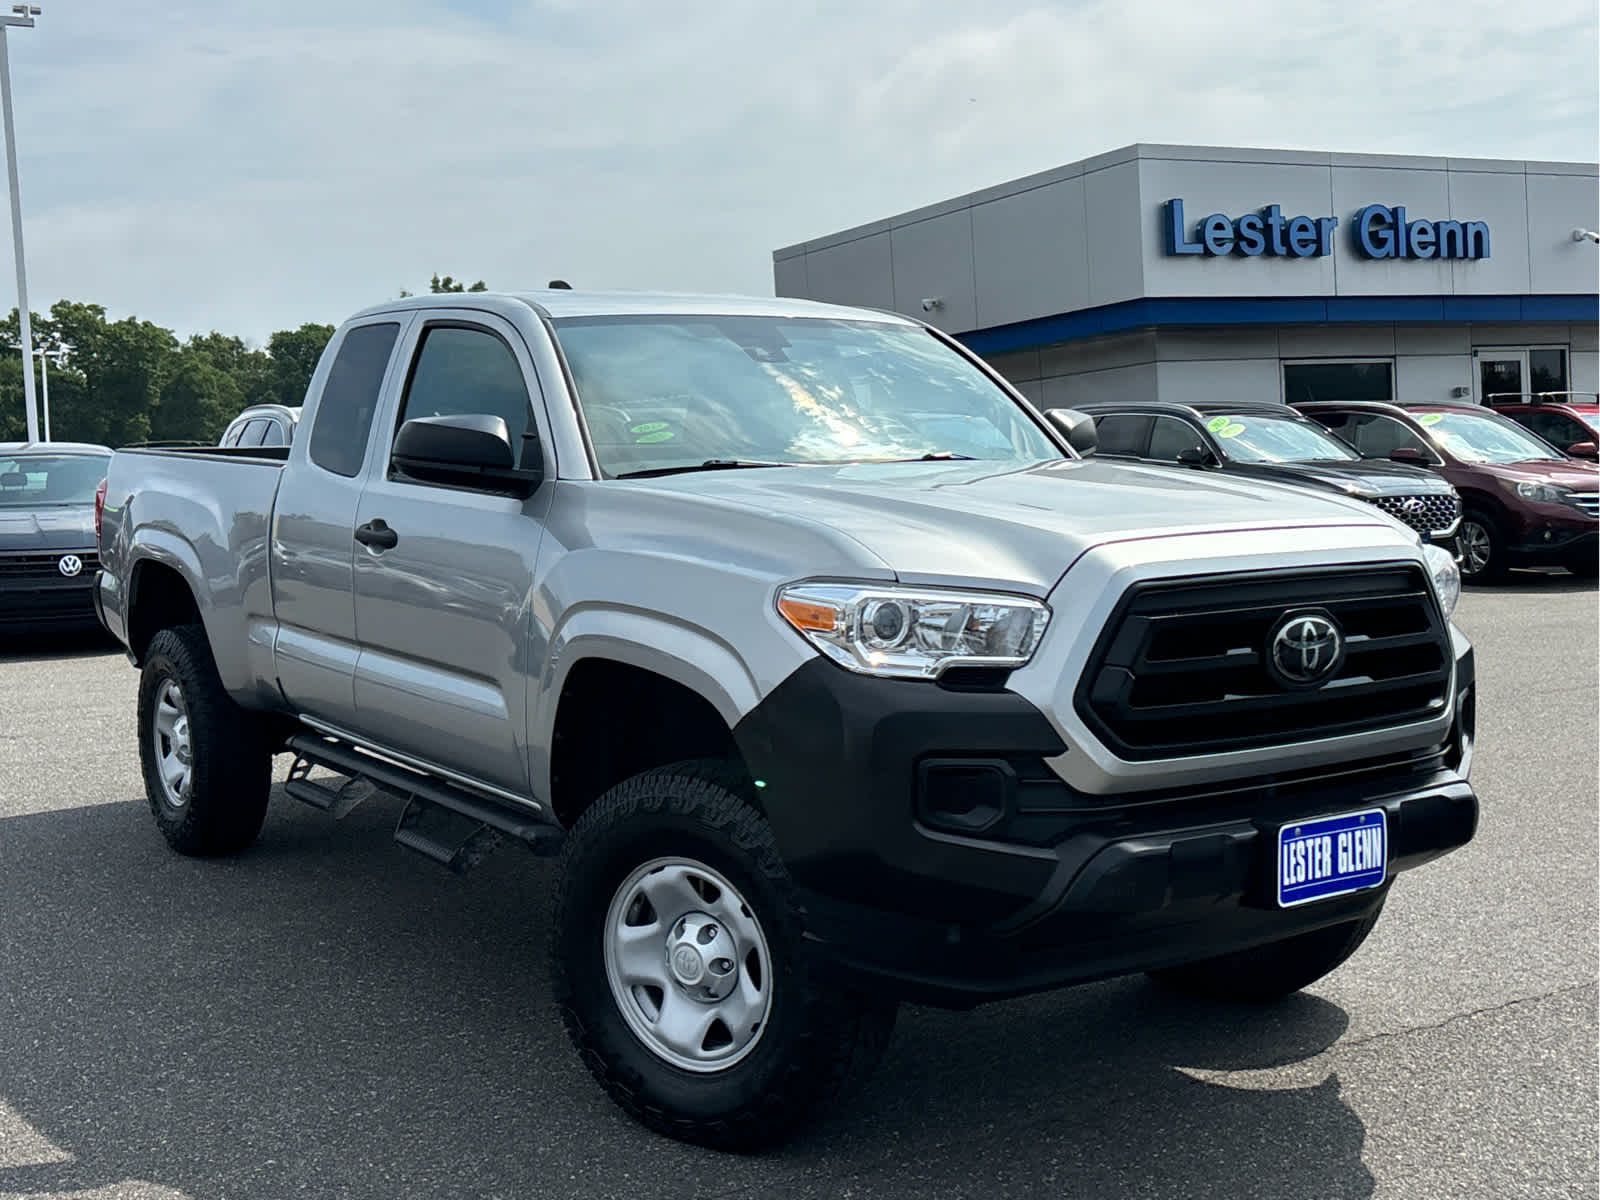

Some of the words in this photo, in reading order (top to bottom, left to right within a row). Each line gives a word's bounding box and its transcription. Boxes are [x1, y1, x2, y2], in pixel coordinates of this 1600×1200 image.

[1163, 198, 1338, 257] Lester
[1354, 204, 1491, 259] Glenn
[1283, 836, 1332, 886] LESTER
[1338, 827, 1382, 874] GLENN
